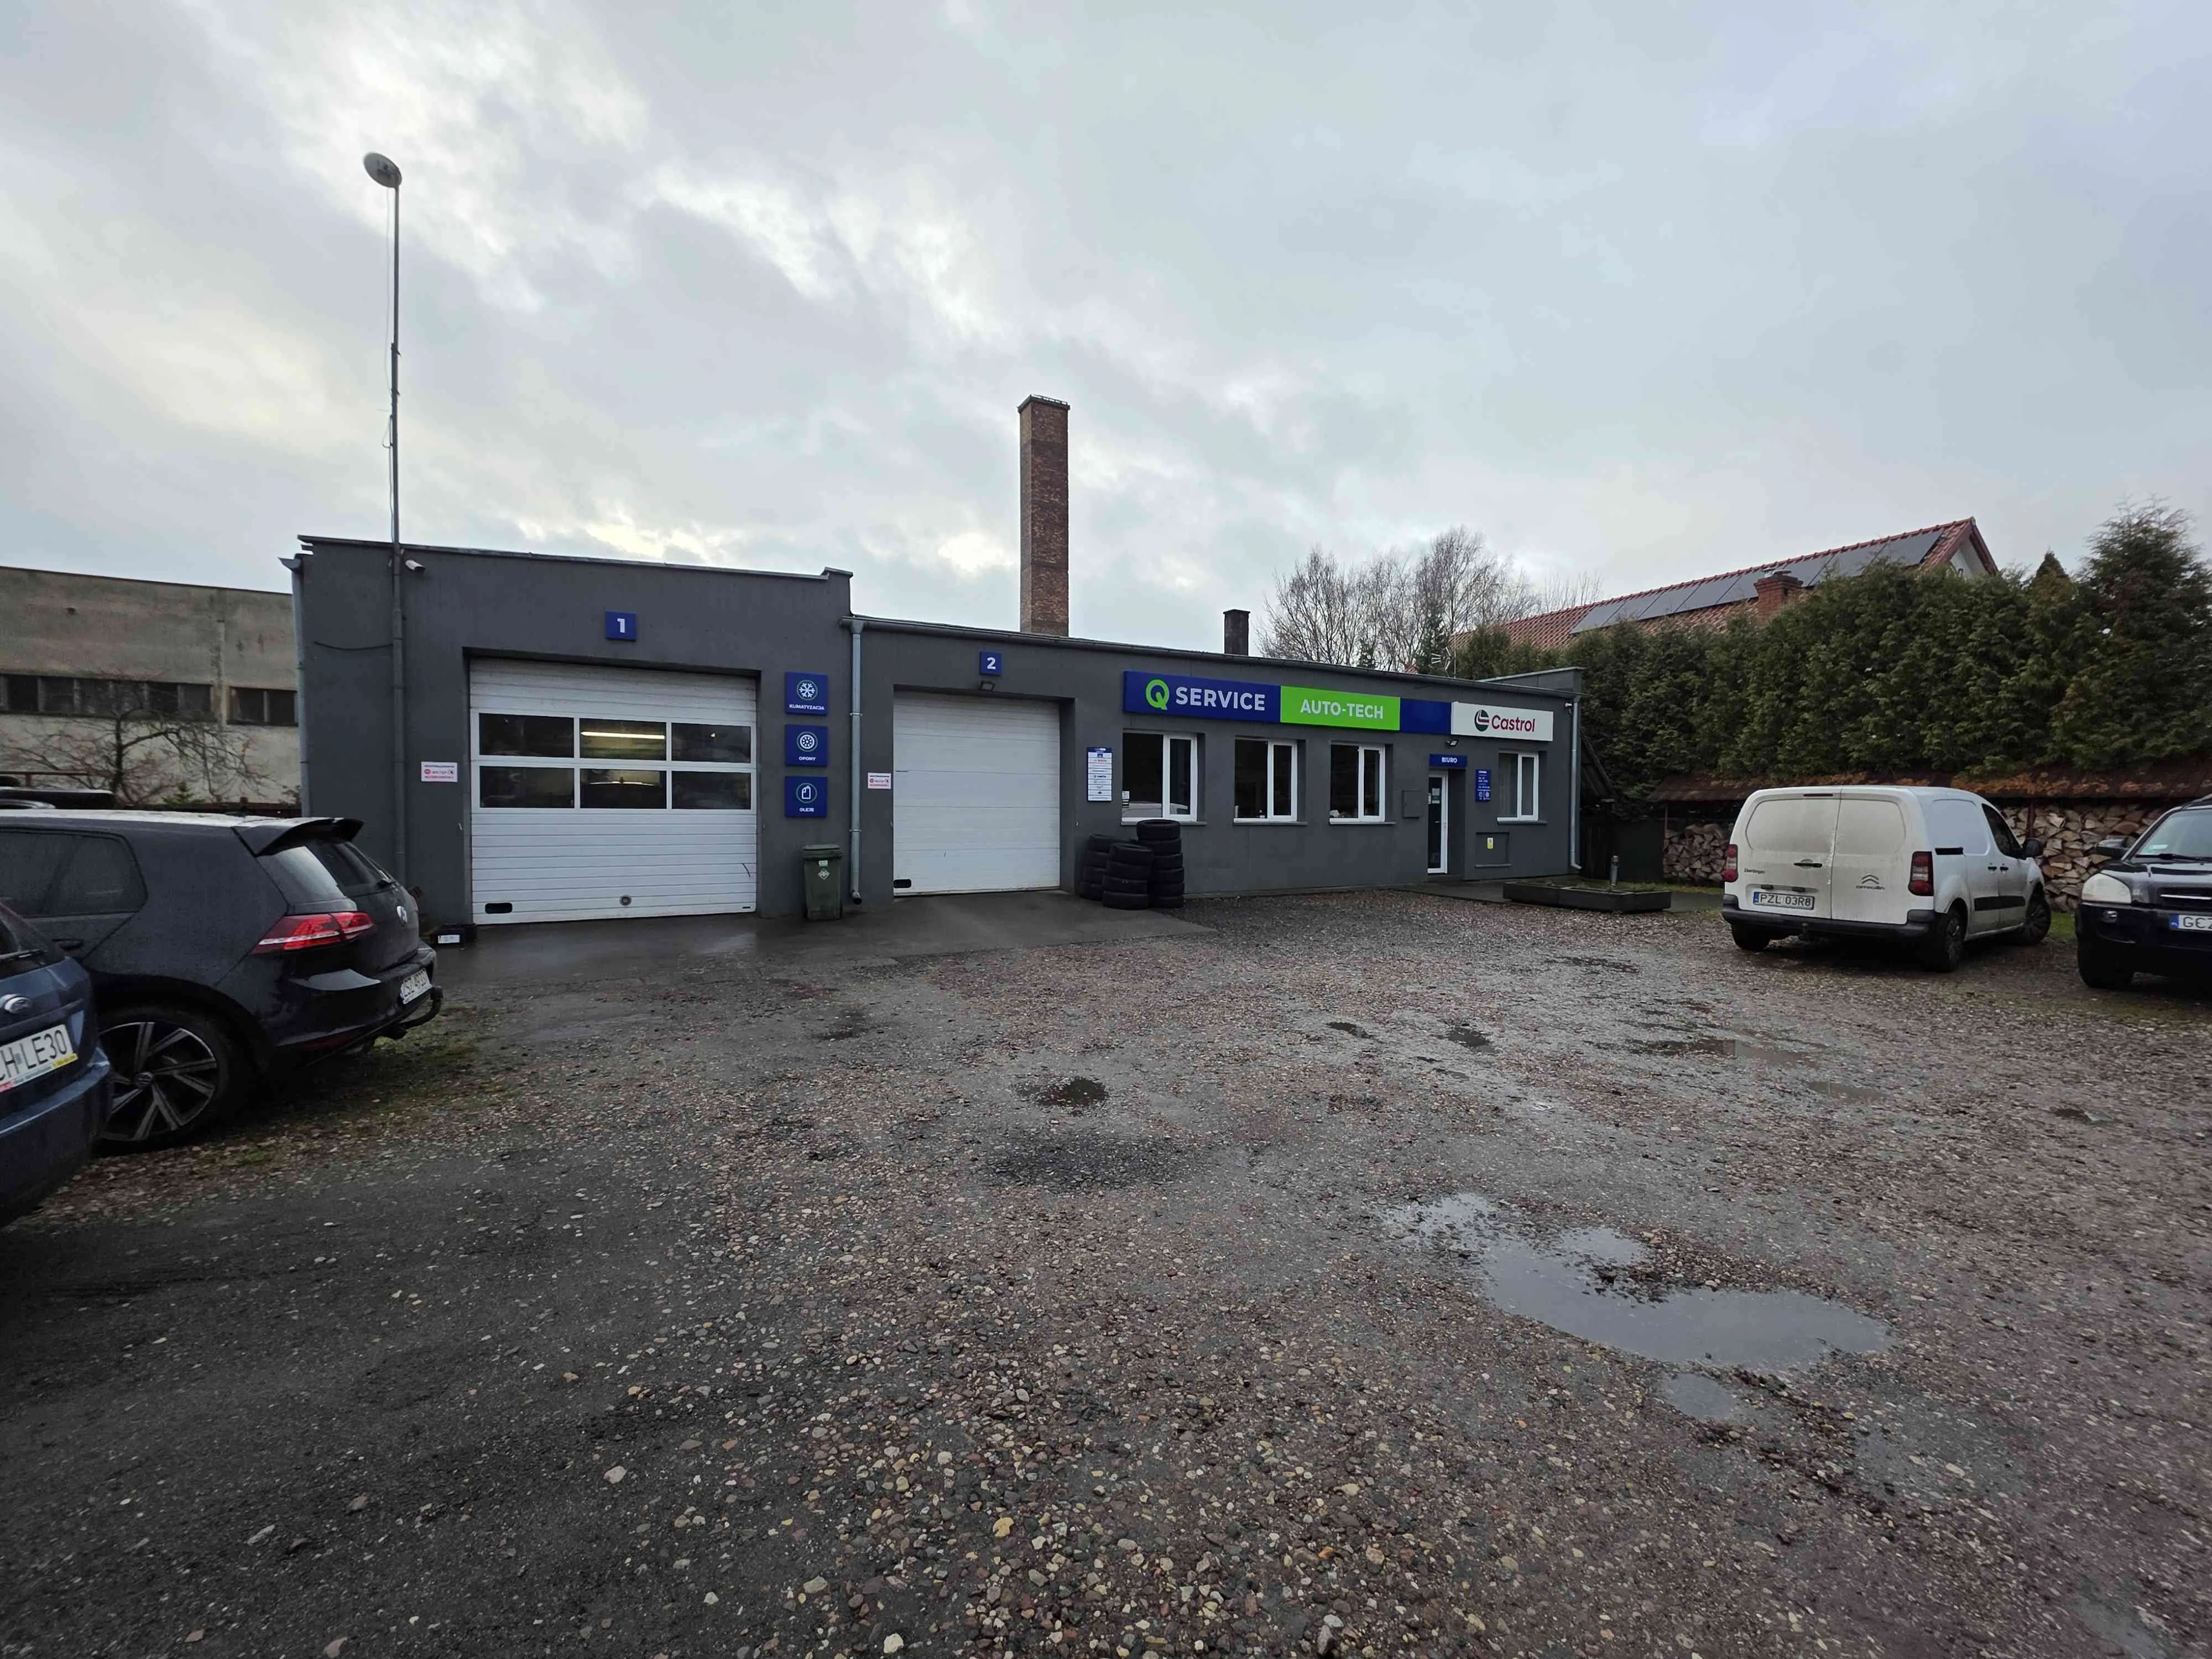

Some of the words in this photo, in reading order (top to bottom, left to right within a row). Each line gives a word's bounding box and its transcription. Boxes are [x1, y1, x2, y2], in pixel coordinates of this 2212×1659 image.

[617, 618, 625, 633] 1
[987, 657, 996, 670] 2
[1145, 679, 1170, 710] Q
[1176, 687, 1265, 711] SERVICE
[1300, 699, 1383, 719] AUTO-TECH
[1491, 714, 1535, 732] Castrol
